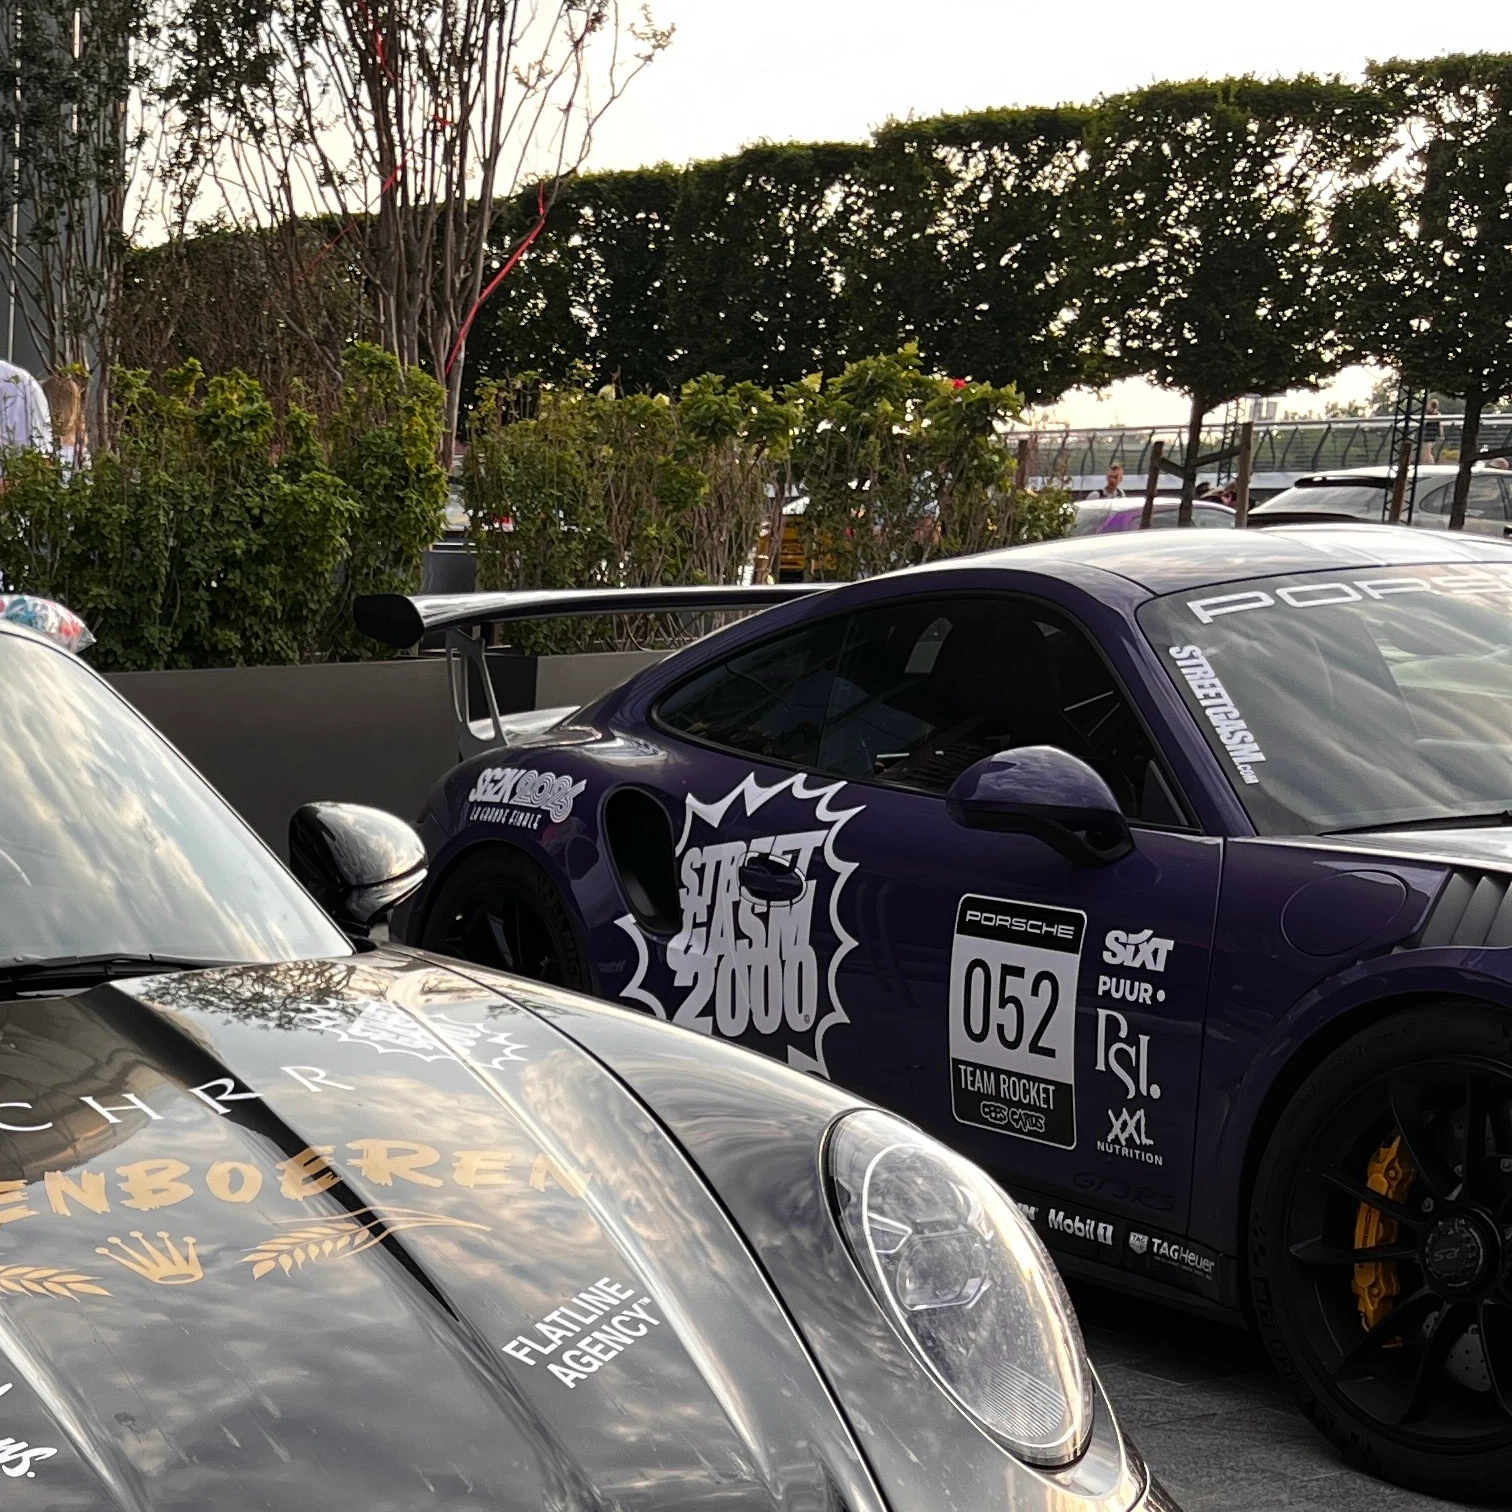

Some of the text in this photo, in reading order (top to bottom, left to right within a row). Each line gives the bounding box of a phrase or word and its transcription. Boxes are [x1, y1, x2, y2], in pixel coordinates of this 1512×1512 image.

[1187, 575, 1512, 625] PORS
[965, 910, 1075, 940] PORSCHE
[666, 942, 819, 1037] 2000
[963, 958, 1060, 1060] 052
[958, 1064, 1056, 1110] TEAM ROCKET
[1106, 1107, 1154, 1147] XXL
[1096, 1140, 1164, 1166] NUTRITION
[1048, 1208, 1096, 1241] Mobil
[501, 1276, 636, 1366] FLATLINE
